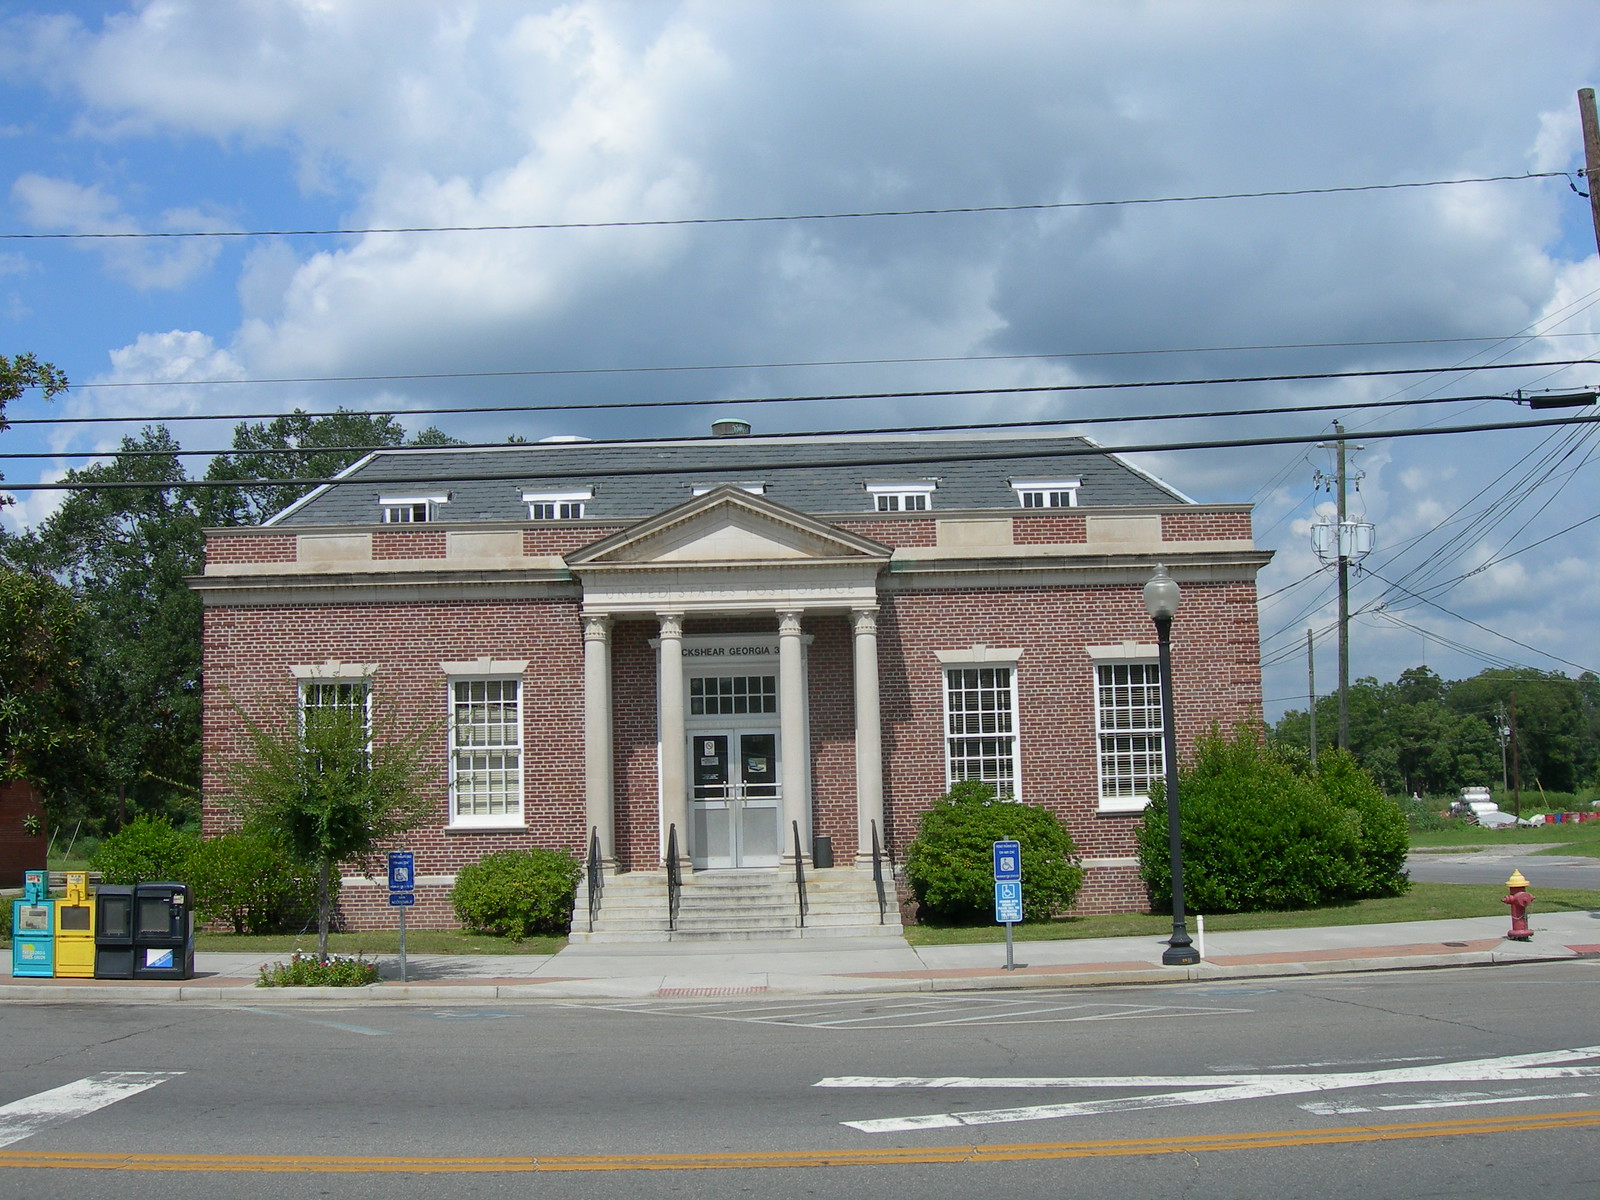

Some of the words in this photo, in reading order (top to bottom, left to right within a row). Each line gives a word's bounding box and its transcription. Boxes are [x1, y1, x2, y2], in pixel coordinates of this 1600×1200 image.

[605, 587, 668, 599] UNITED
[677, 585, 736, 598] STATES
[746, 584, 785, 596] POST
[796, 582, 855, 595] OFFICE
[681, 648, 725, 657] CKSHEAR
[729, 646, 770, 656] GEORGIA
